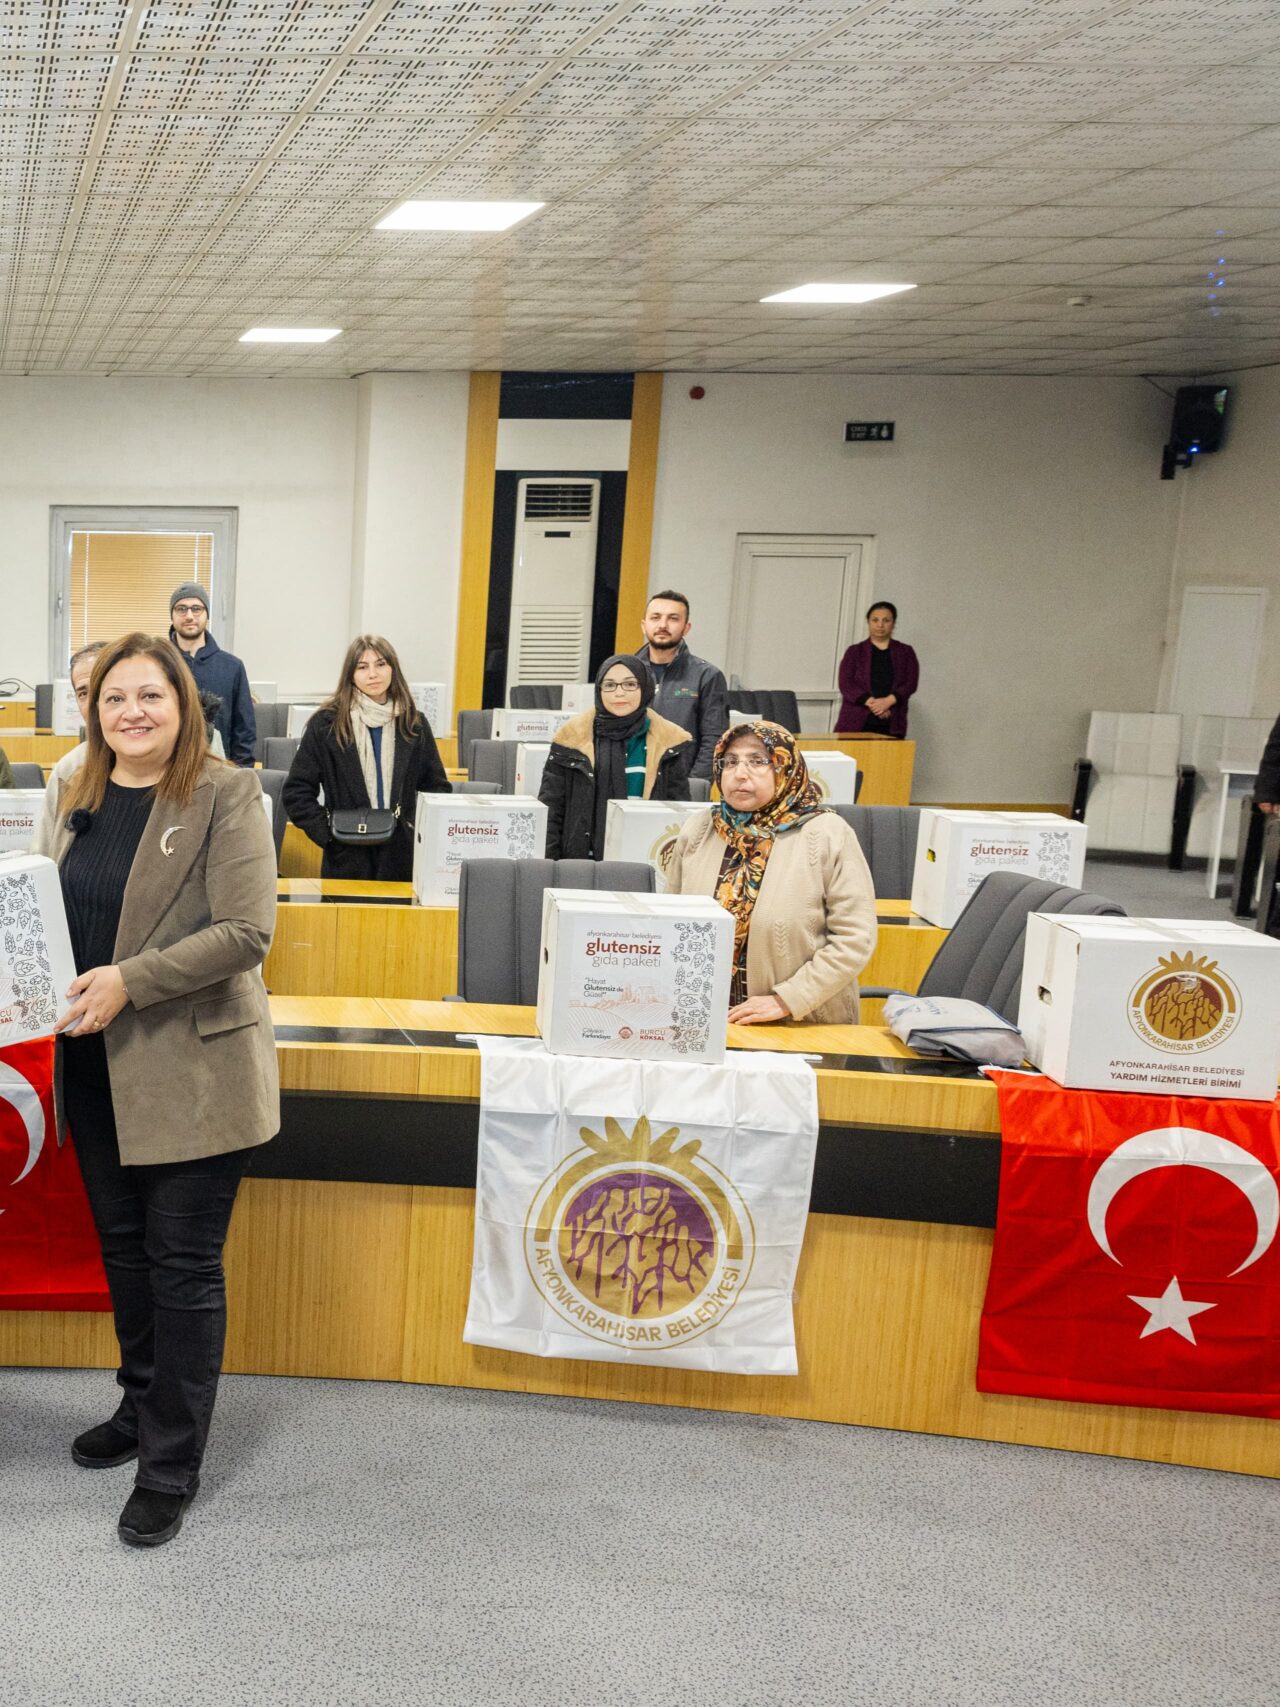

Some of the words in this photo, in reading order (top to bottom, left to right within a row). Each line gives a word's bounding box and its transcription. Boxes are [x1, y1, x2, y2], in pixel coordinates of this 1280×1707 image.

[448, 824, 499, 836] glutensiz
[970, 843, 1029, 857] glutensiz
[586, 937, 661, 956] glutensiz
[592, 953, 618, 967] gıda
[623, 954, 661, 968] paketi
[584, 984, 616, 992] Glutensiz
[1133, 1010, 1194, 1051] AFYONKARAHİSAR
[1109, 1061, 1190, 1072] AFYONKARAHİSAR
[1193, 1066, 1245, 1076] BELEDİYESİ
[1110, 1072, 1147, 1082] YARDIM
[1150, 1074, 1207, 1086] HİZMETLERİ
[1211, 1079, 1241, 1088] BİRİMİ
[535, 1247, 662, 1342] AFYONKARAHİSAR
[666, 1266, 741, 1339] BELEDİYESİ
